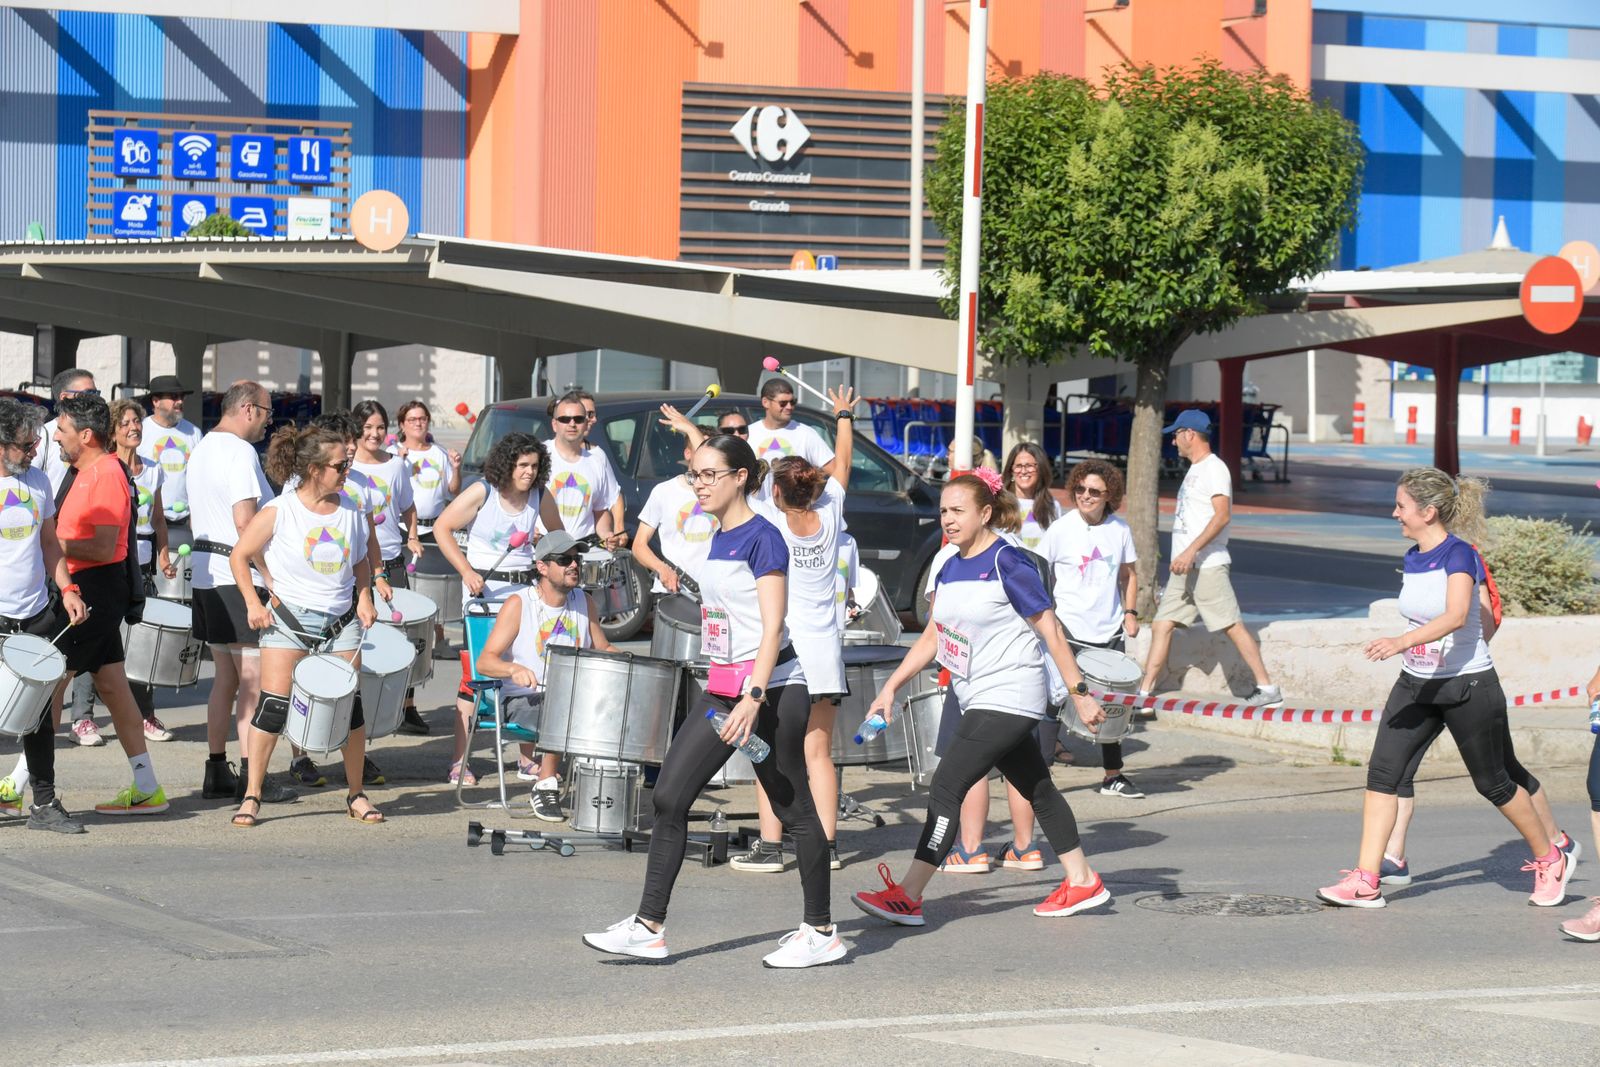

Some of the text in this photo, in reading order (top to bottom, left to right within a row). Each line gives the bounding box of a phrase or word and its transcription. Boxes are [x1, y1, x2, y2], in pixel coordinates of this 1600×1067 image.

[129, 166, 150, 174] tiendas
[183, 168, 207, 176] Gratuito
[237, 170, 267, 179] Gasolinera
[729, 170, 811, 184] Centro Comercial
[749, 200, 790, 213] Granada
[369, 206, 393, 235] H
[114, 228, 156, 236] Complementos
[926, 815, 950, 851] PUMA
